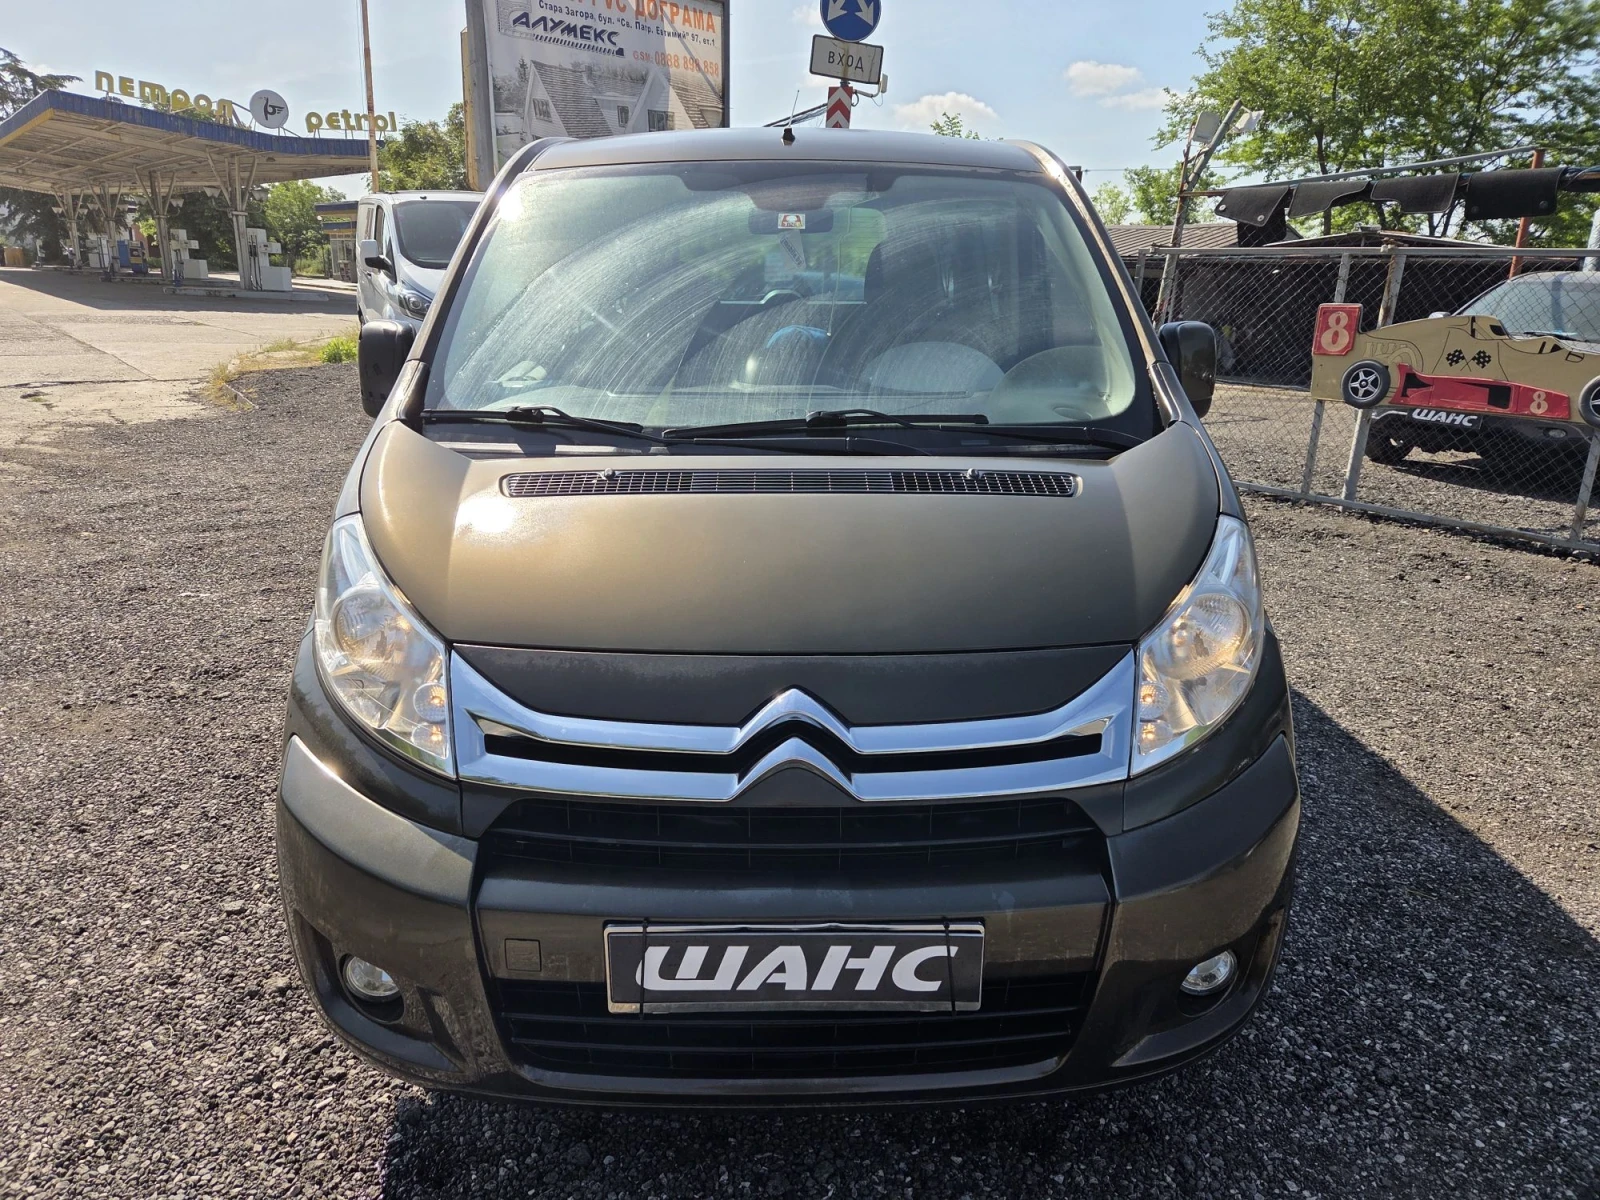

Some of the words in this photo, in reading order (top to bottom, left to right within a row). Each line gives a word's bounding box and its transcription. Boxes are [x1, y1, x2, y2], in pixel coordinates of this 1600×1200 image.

[539, 0, 563, 14] Стара
[598, 13, 615, 25] бул.
[635, 0, 716, 34] ДОГРАМА
[513, 11, 620, 47] АЛУМЕКС
[655, 51, 681, 70] 0888
[703, 59, 719, 77] 858
[827, 50, 864, 73] ВХОД
[305, 109, 397, 133] petrol
[1320, 311, 1350, 352] 8
[1529, 391, 1549, 415] 8
[1412, 408, 1478, 428] ШАНС
[635, 945, 959, 992] ШАНС
